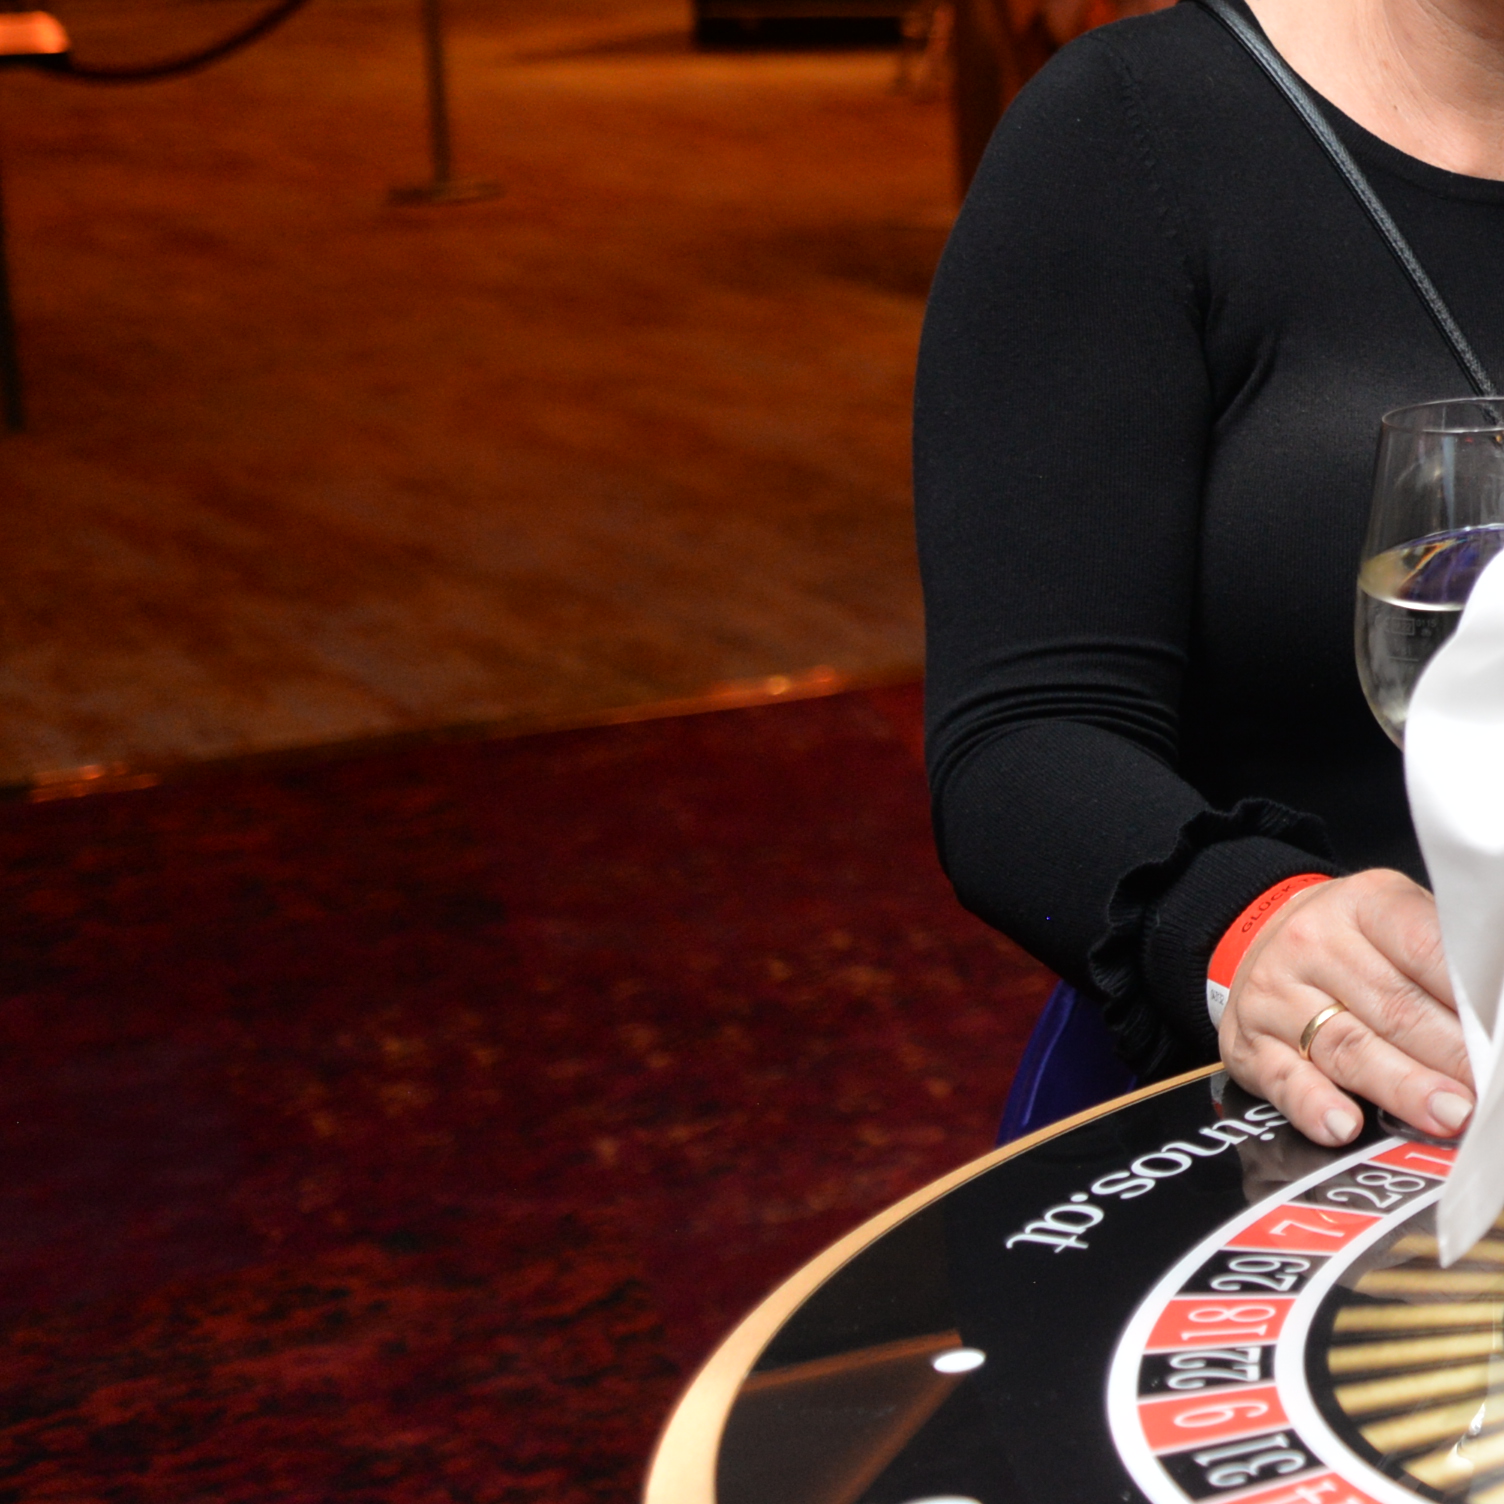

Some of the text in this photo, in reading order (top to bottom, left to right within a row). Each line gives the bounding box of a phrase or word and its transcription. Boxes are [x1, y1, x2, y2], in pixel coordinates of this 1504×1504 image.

[1241, 884, 1297, 933] GLÜCK
[1327, 1170, 1426, 1209] 28
[1269, 1219, 1346, 1239] 7
[1210, 1254, 1311, 1292] 29
[1180, 1304, 1277, 1342] 18
[1167, 1346, 1262, 1390] 22
[1193, 1432, 1307, 1488] 31
